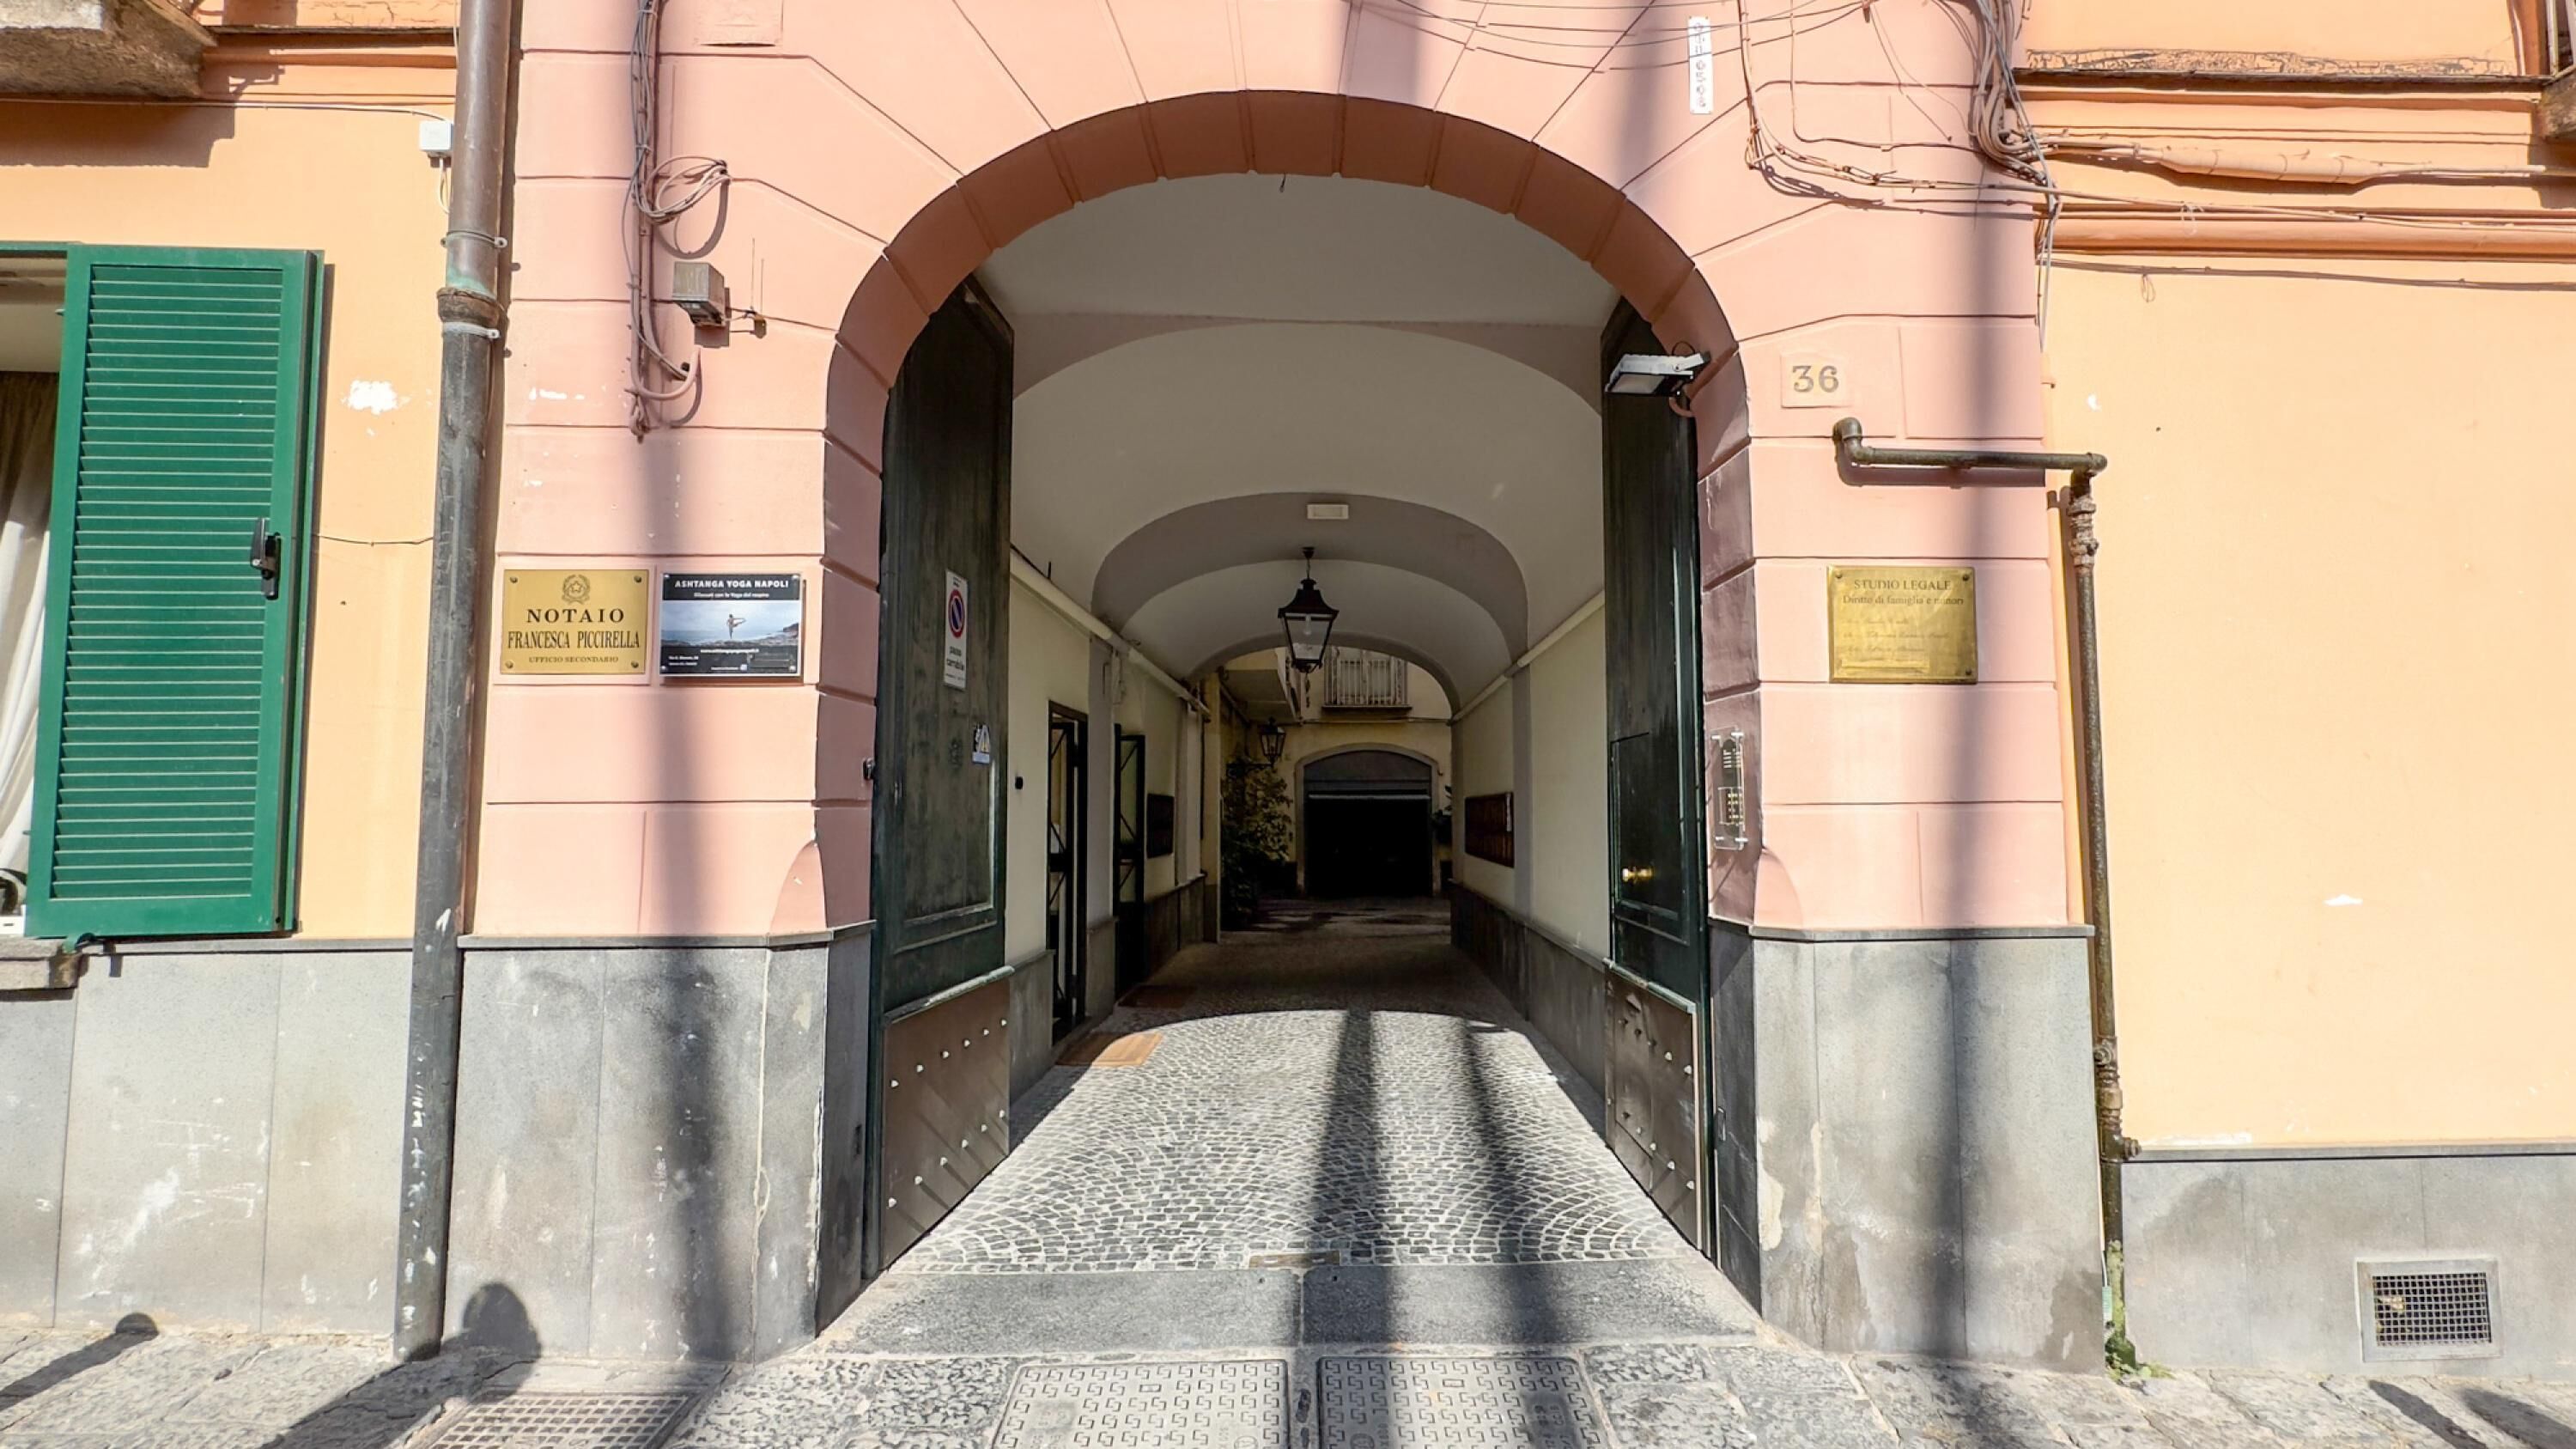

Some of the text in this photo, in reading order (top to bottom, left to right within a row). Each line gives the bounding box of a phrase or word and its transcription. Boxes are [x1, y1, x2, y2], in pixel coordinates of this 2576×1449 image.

[1791, 365, 1839, 393] 36
[674, 580, 789, 589] ASHTANGA YOGA NAPOLI
[1854, 579, 1952, 591] STUDIO LEGALE
[526, 608, 624, 624] NOTAIO
[507, 630, 640, 649] FRANCESCA PICCIRELLA
[528, 655, 619, 664] UFFICIO SECONDARIO
